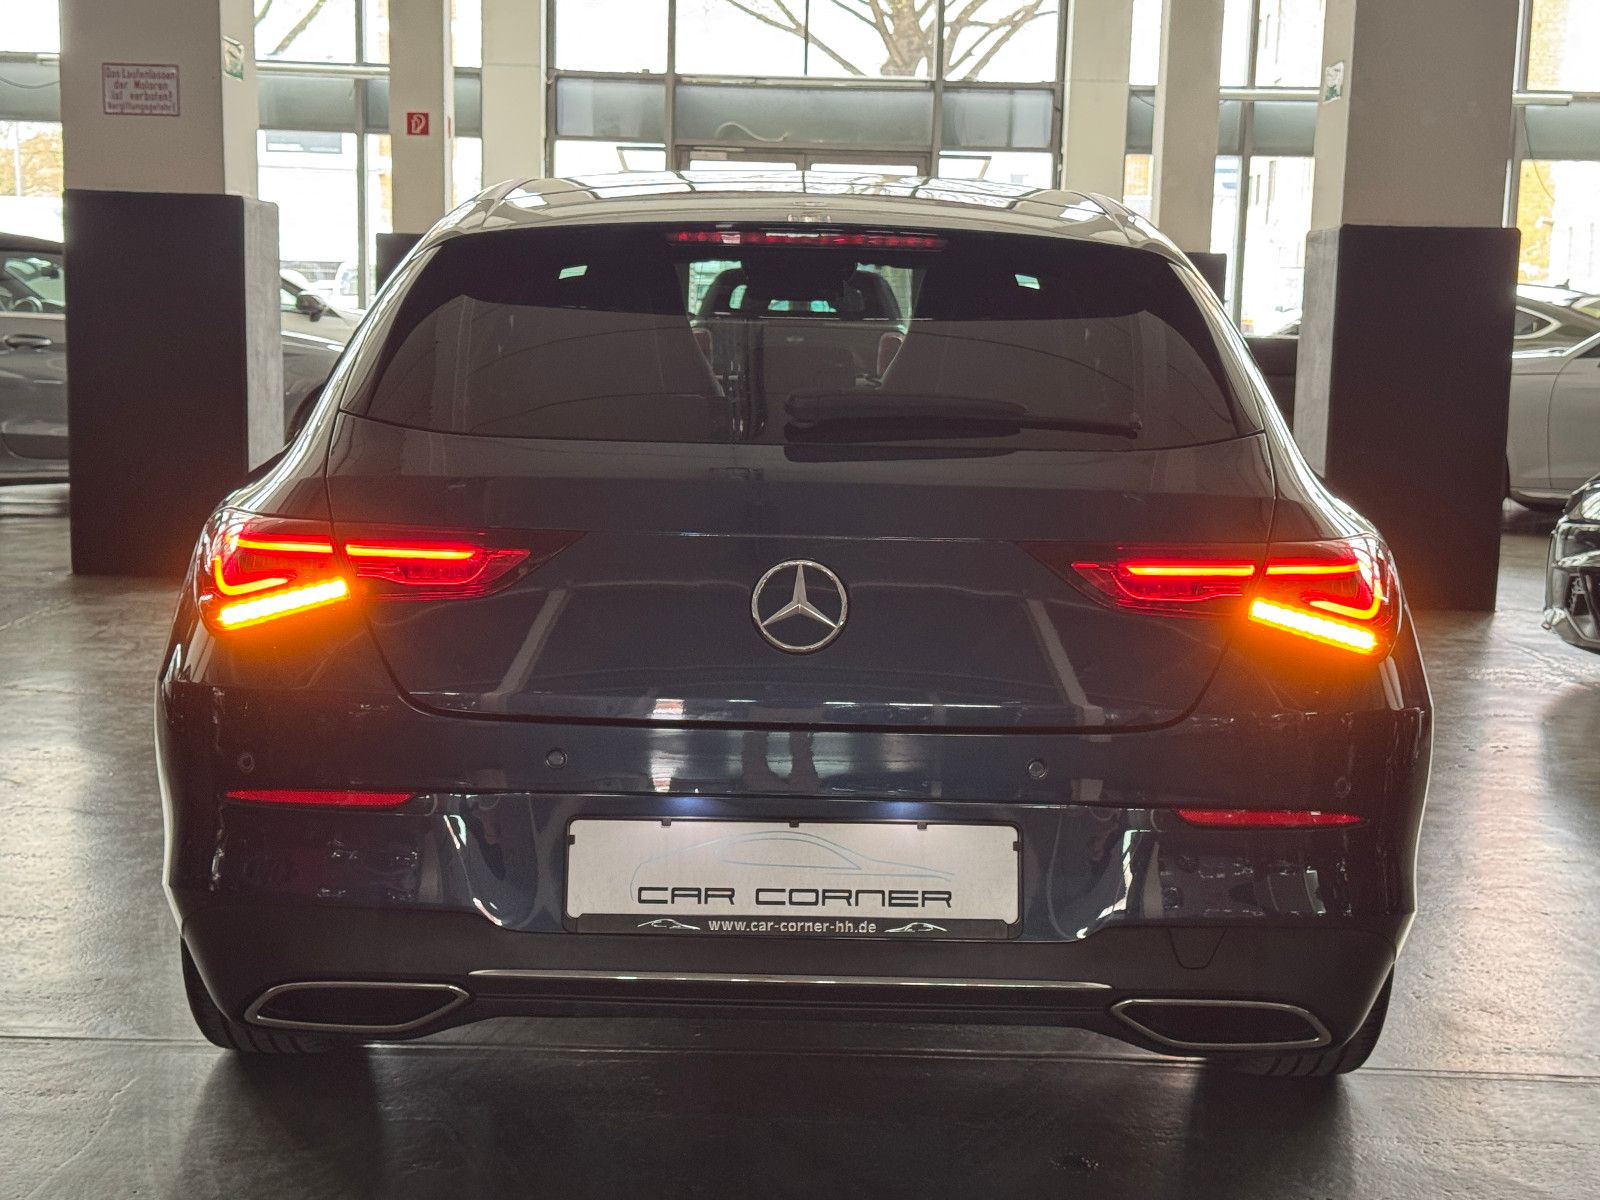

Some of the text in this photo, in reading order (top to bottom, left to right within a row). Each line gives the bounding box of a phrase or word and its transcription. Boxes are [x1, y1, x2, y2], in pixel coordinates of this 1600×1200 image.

[637, 886, 952, 908] CAR CORNER
[708, 919, 877, 934] www.car-corner-hh.de
